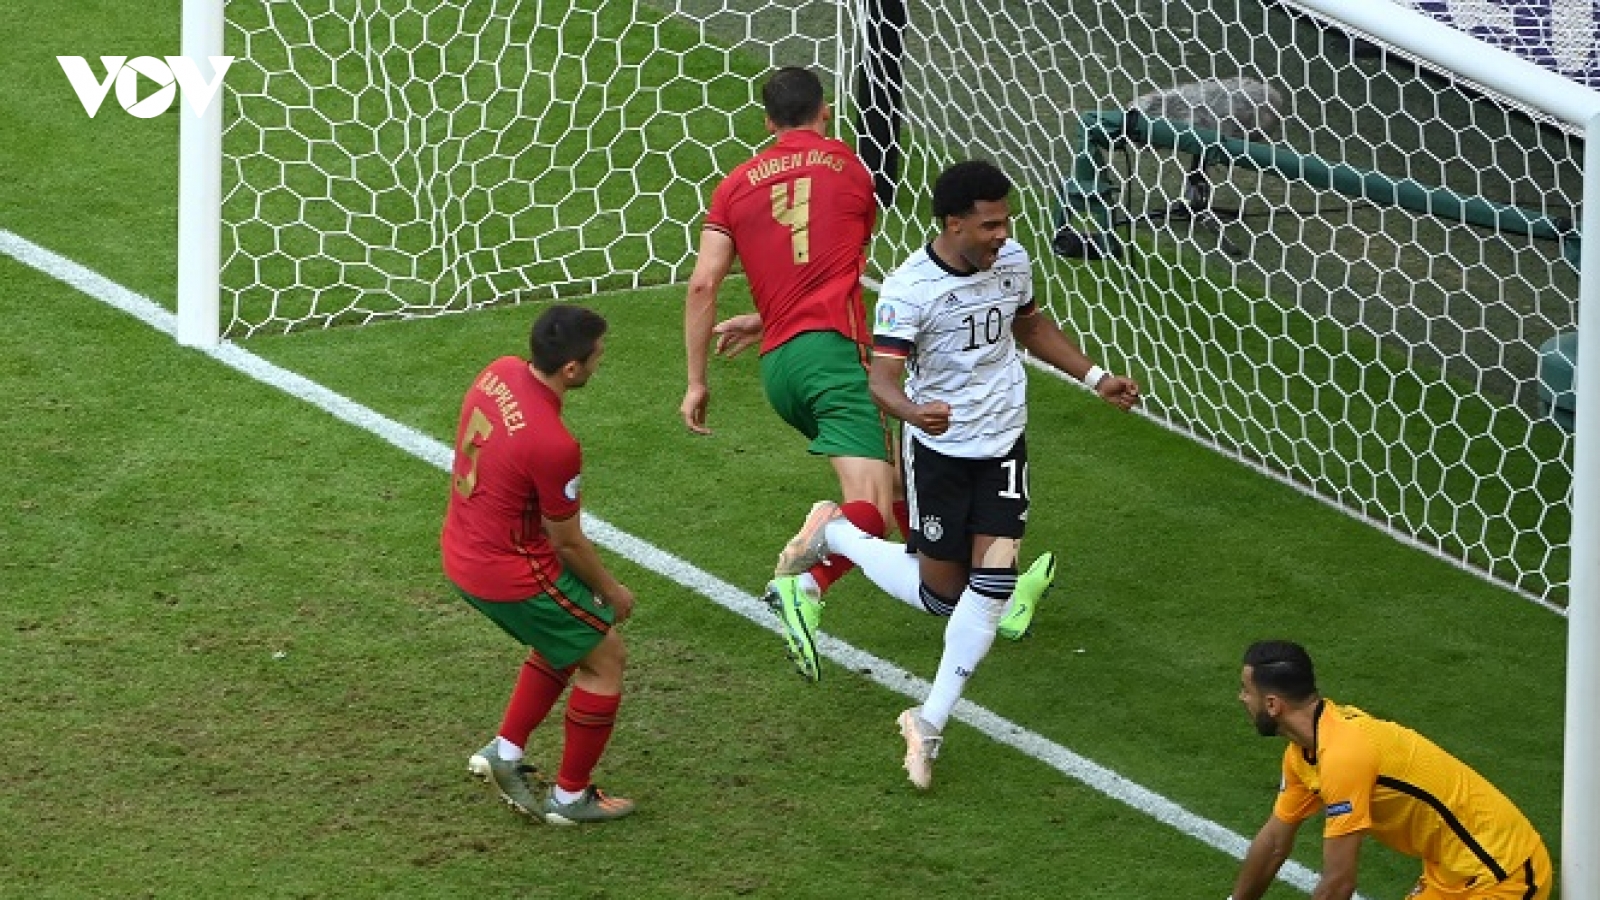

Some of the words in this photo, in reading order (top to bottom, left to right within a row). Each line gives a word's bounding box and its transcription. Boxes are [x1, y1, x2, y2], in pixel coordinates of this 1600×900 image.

[805, 149, 845, 173] DIAS
[770, 177, 811, 265] 4
[962, 307, 1001, 351] 10
[455, 406, 493, 498] 5
